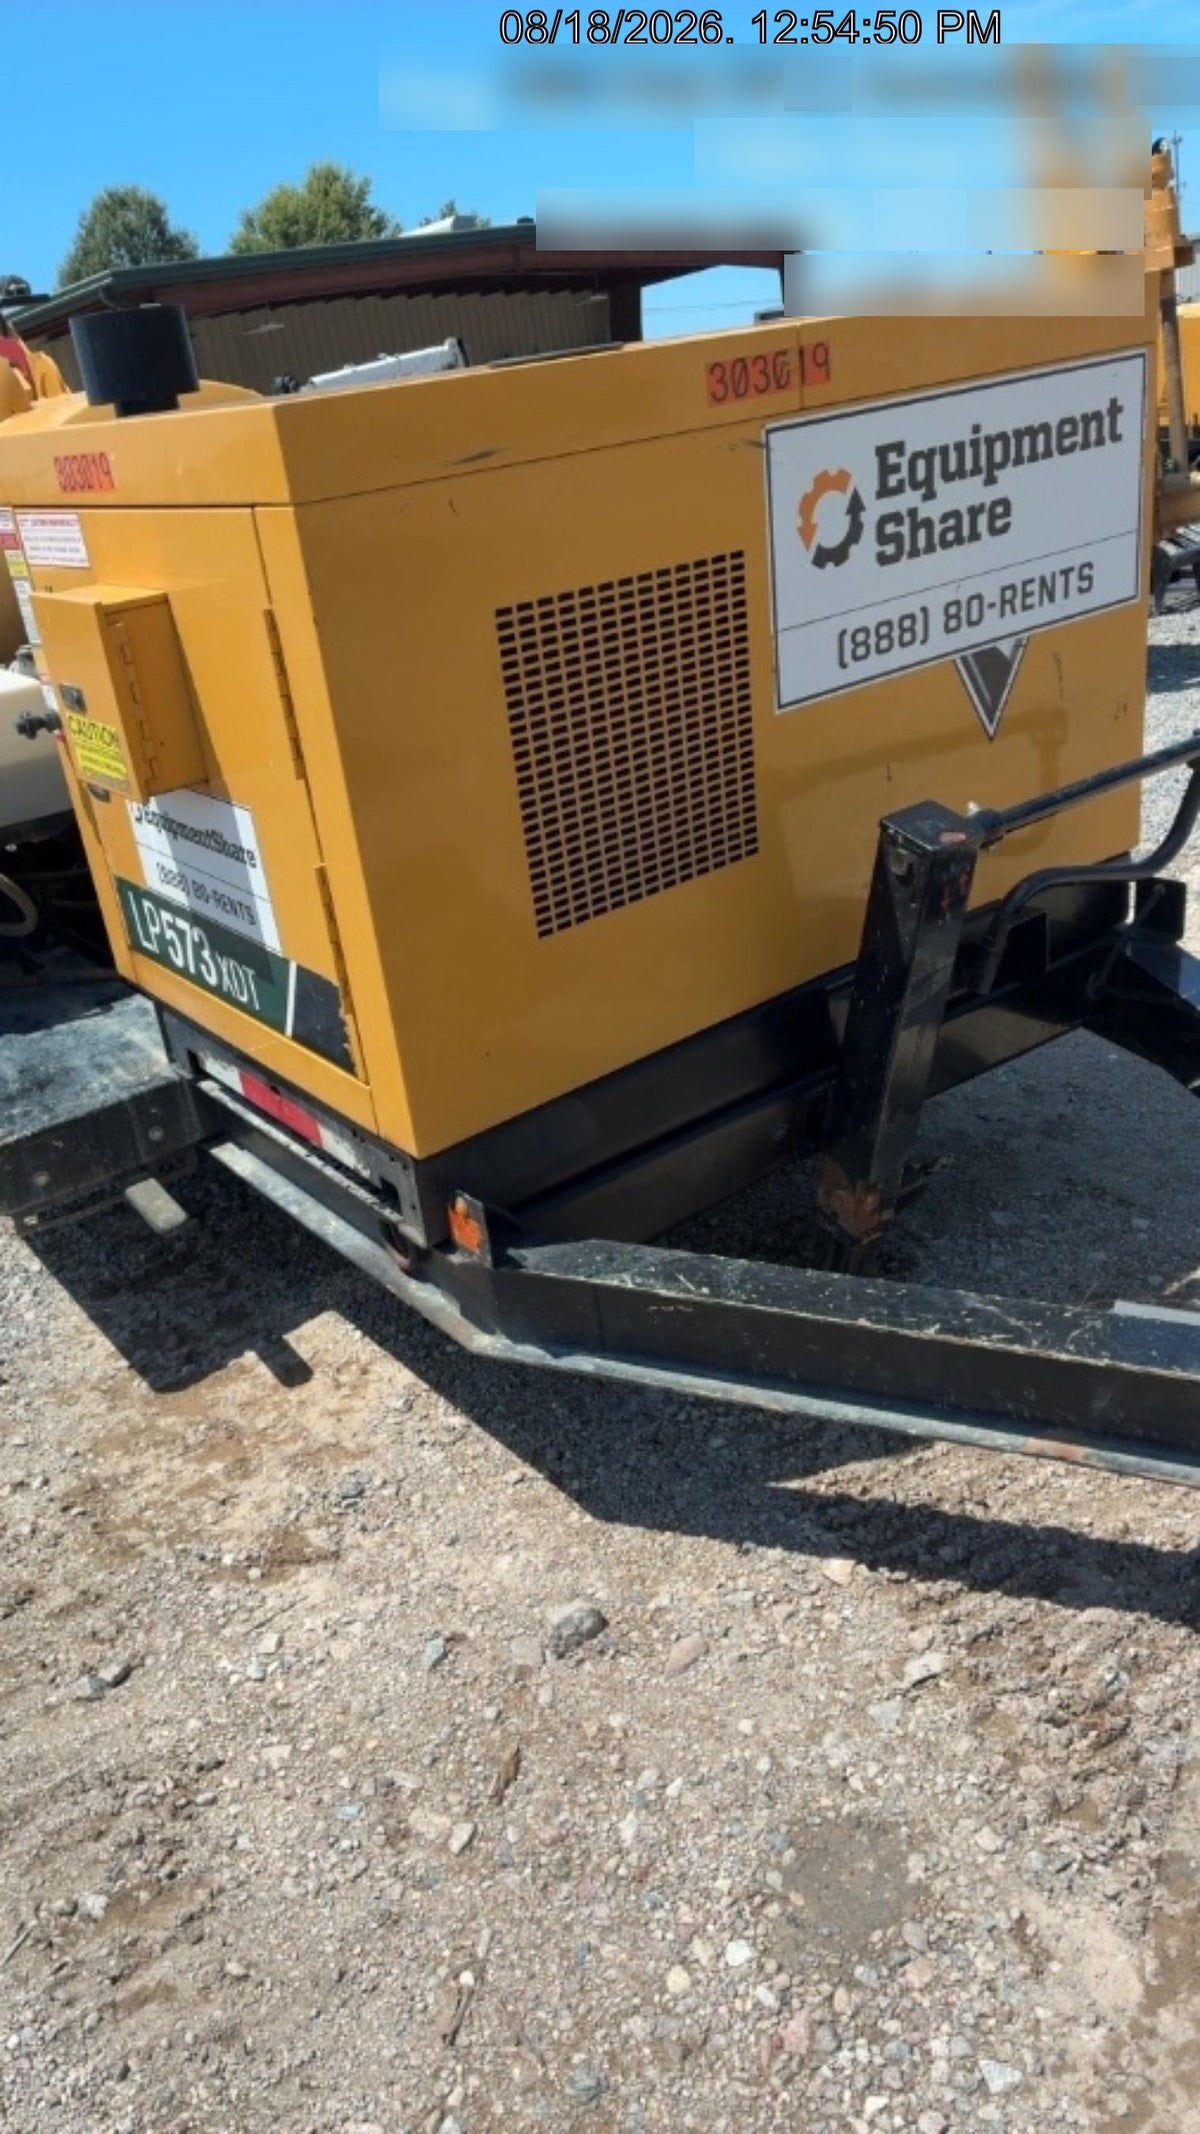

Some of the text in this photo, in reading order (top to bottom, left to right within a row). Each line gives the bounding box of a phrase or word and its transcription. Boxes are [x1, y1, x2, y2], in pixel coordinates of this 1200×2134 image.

[874, 397, 1125, 502] Equipment
[875, 497, 1012, 567] Share
[837, 561, 1095, 668] (888) 80-RENTS
[68, 715, 121, 752] CAUTION
